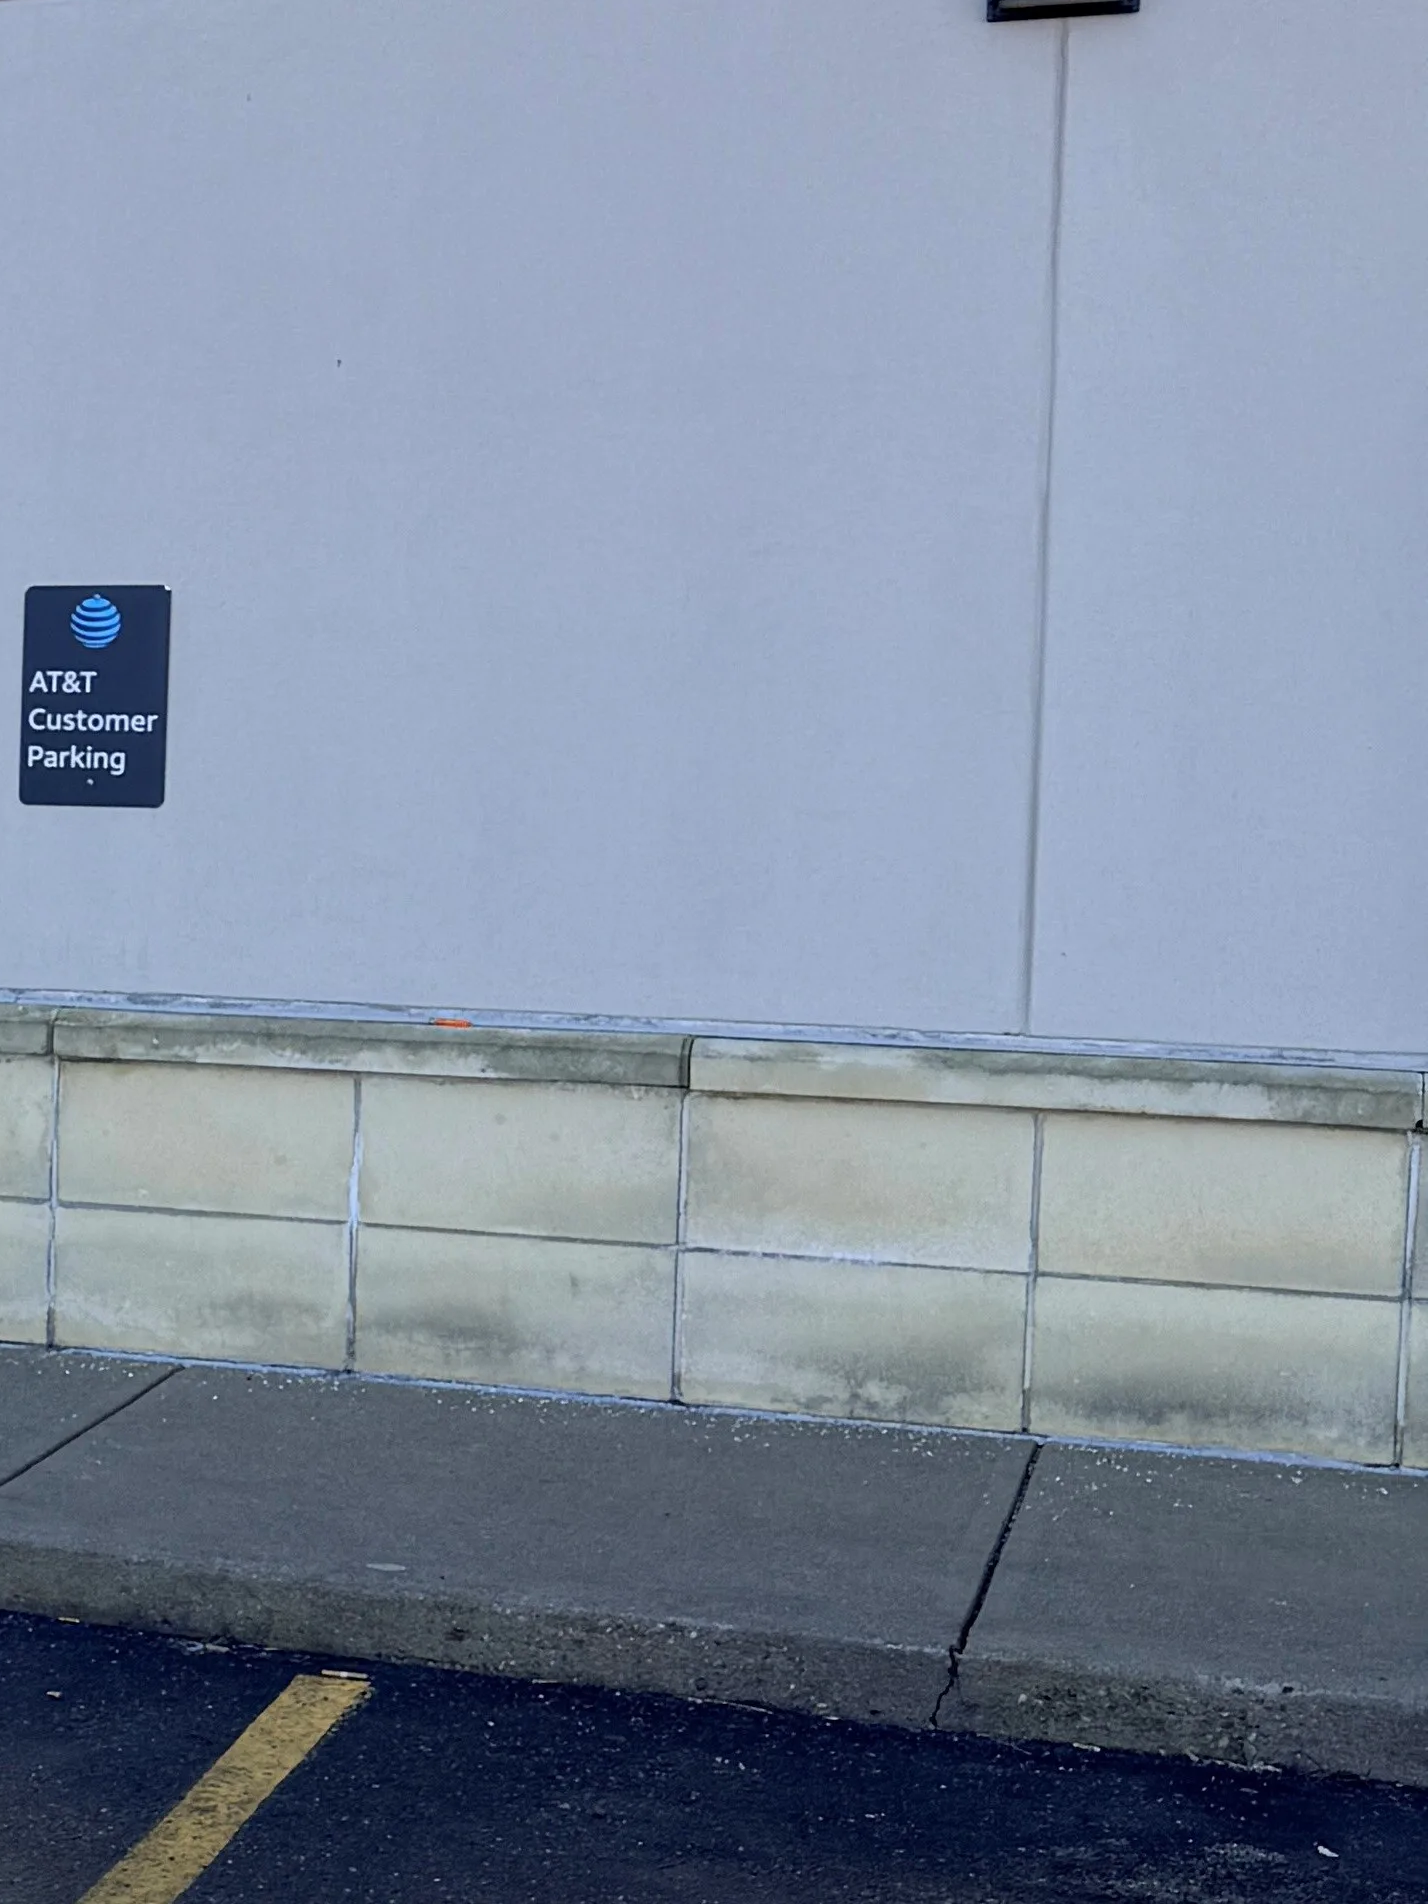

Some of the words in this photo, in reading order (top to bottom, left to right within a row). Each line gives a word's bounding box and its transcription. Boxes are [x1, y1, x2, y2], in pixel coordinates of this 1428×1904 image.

[29, 670, 97, 693] AT&T
[28, 708, 158, 732] Customer
[27, 745, 126, 775] Parking
